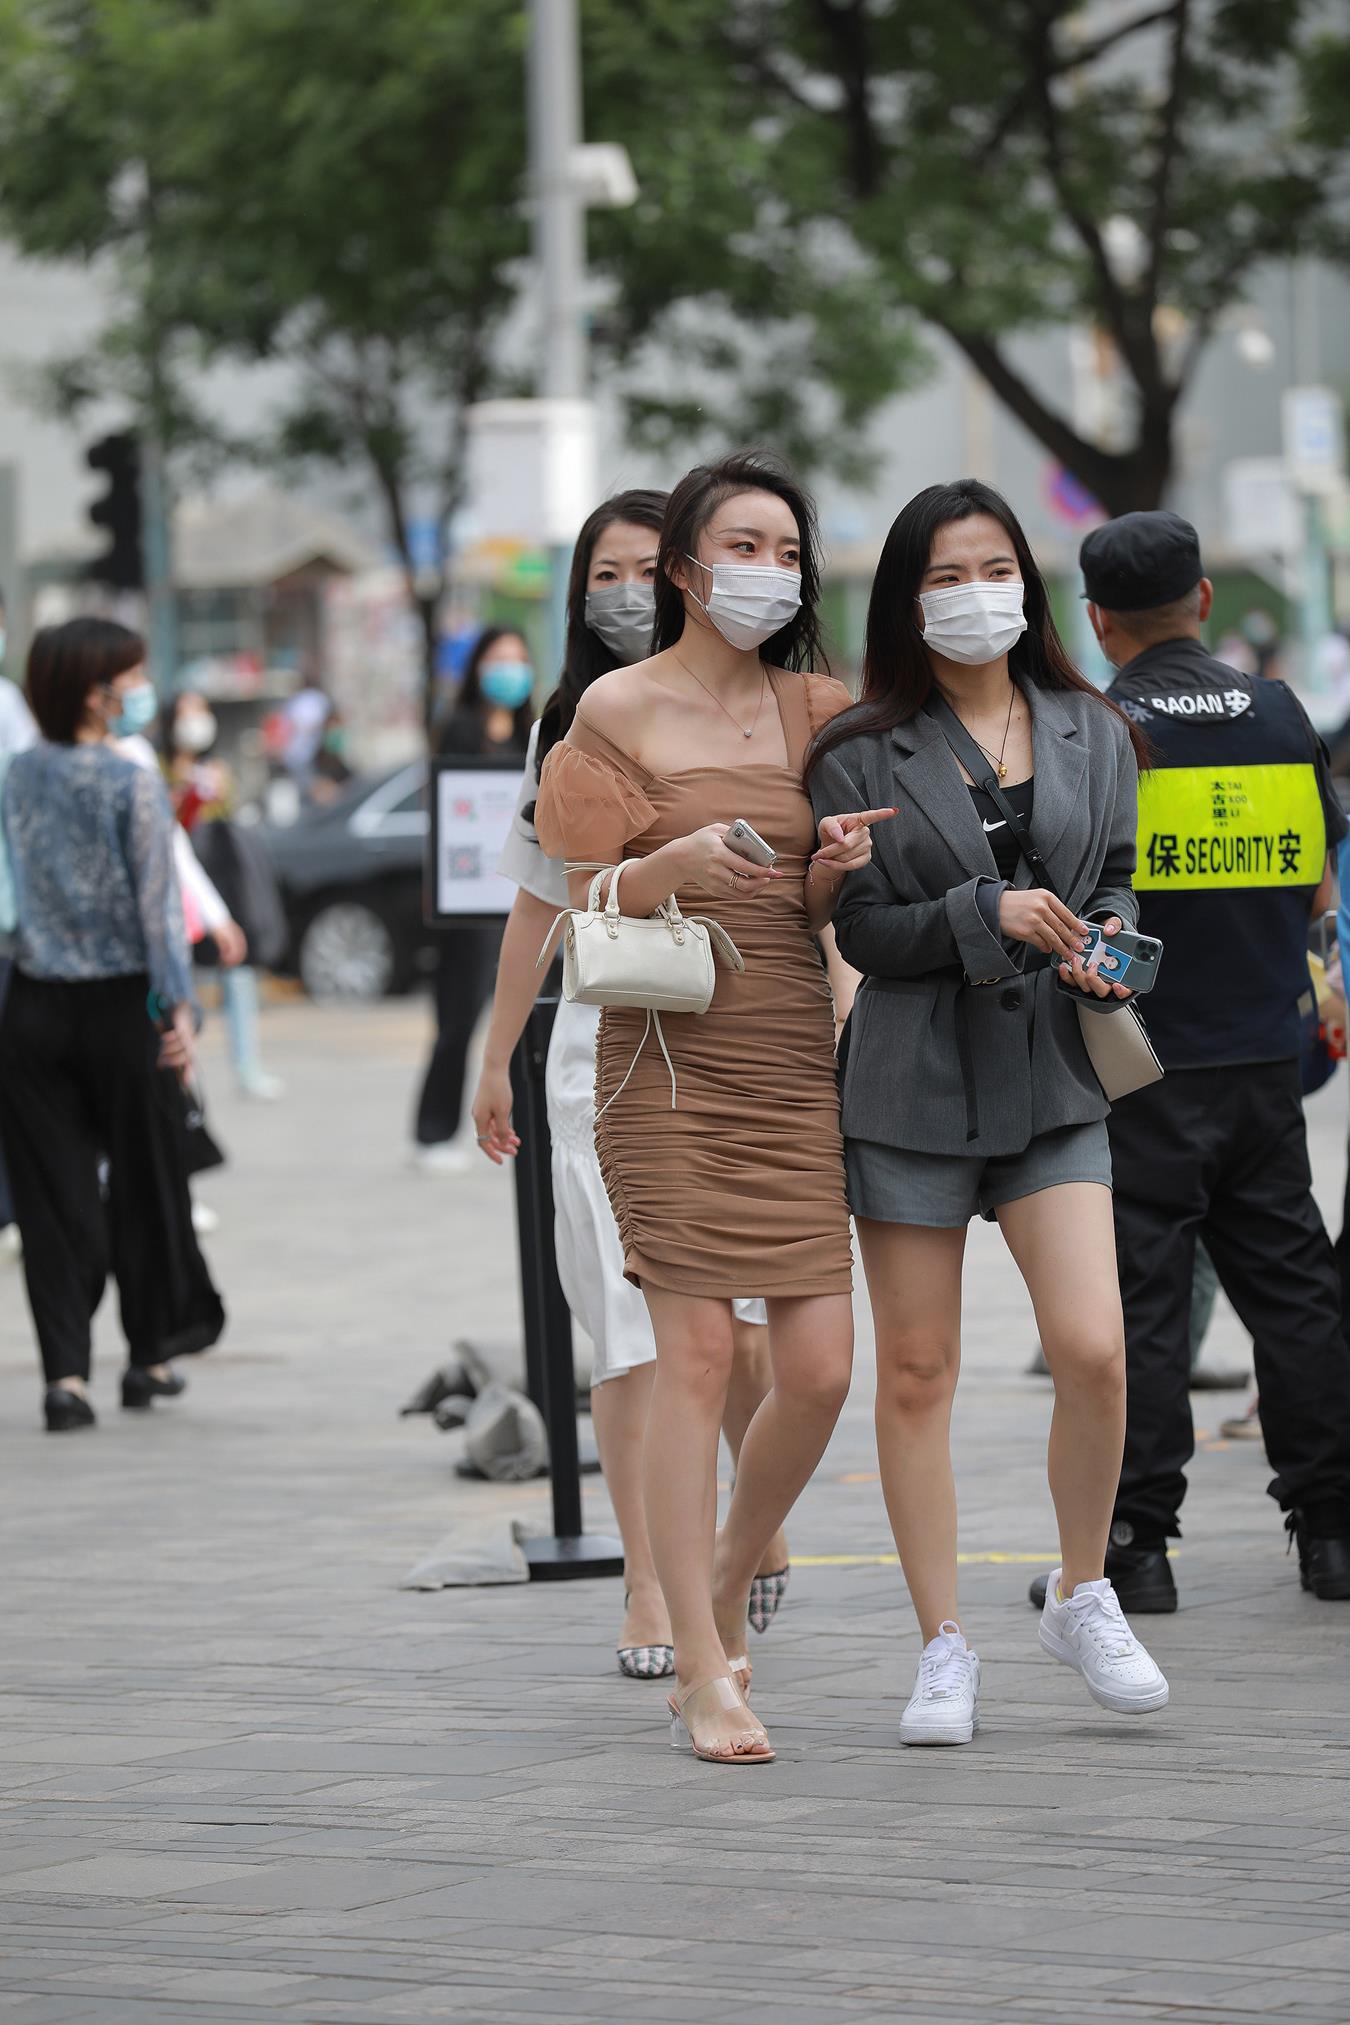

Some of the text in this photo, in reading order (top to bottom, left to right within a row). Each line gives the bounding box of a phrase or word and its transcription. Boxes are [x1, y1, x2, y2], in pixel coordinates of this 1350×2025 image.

[1228, 782, 1242, 790] TAI
[1231, 809, 1240, 817] LI
[1146, 829, 1301, 877] 保 SECURITY 安
